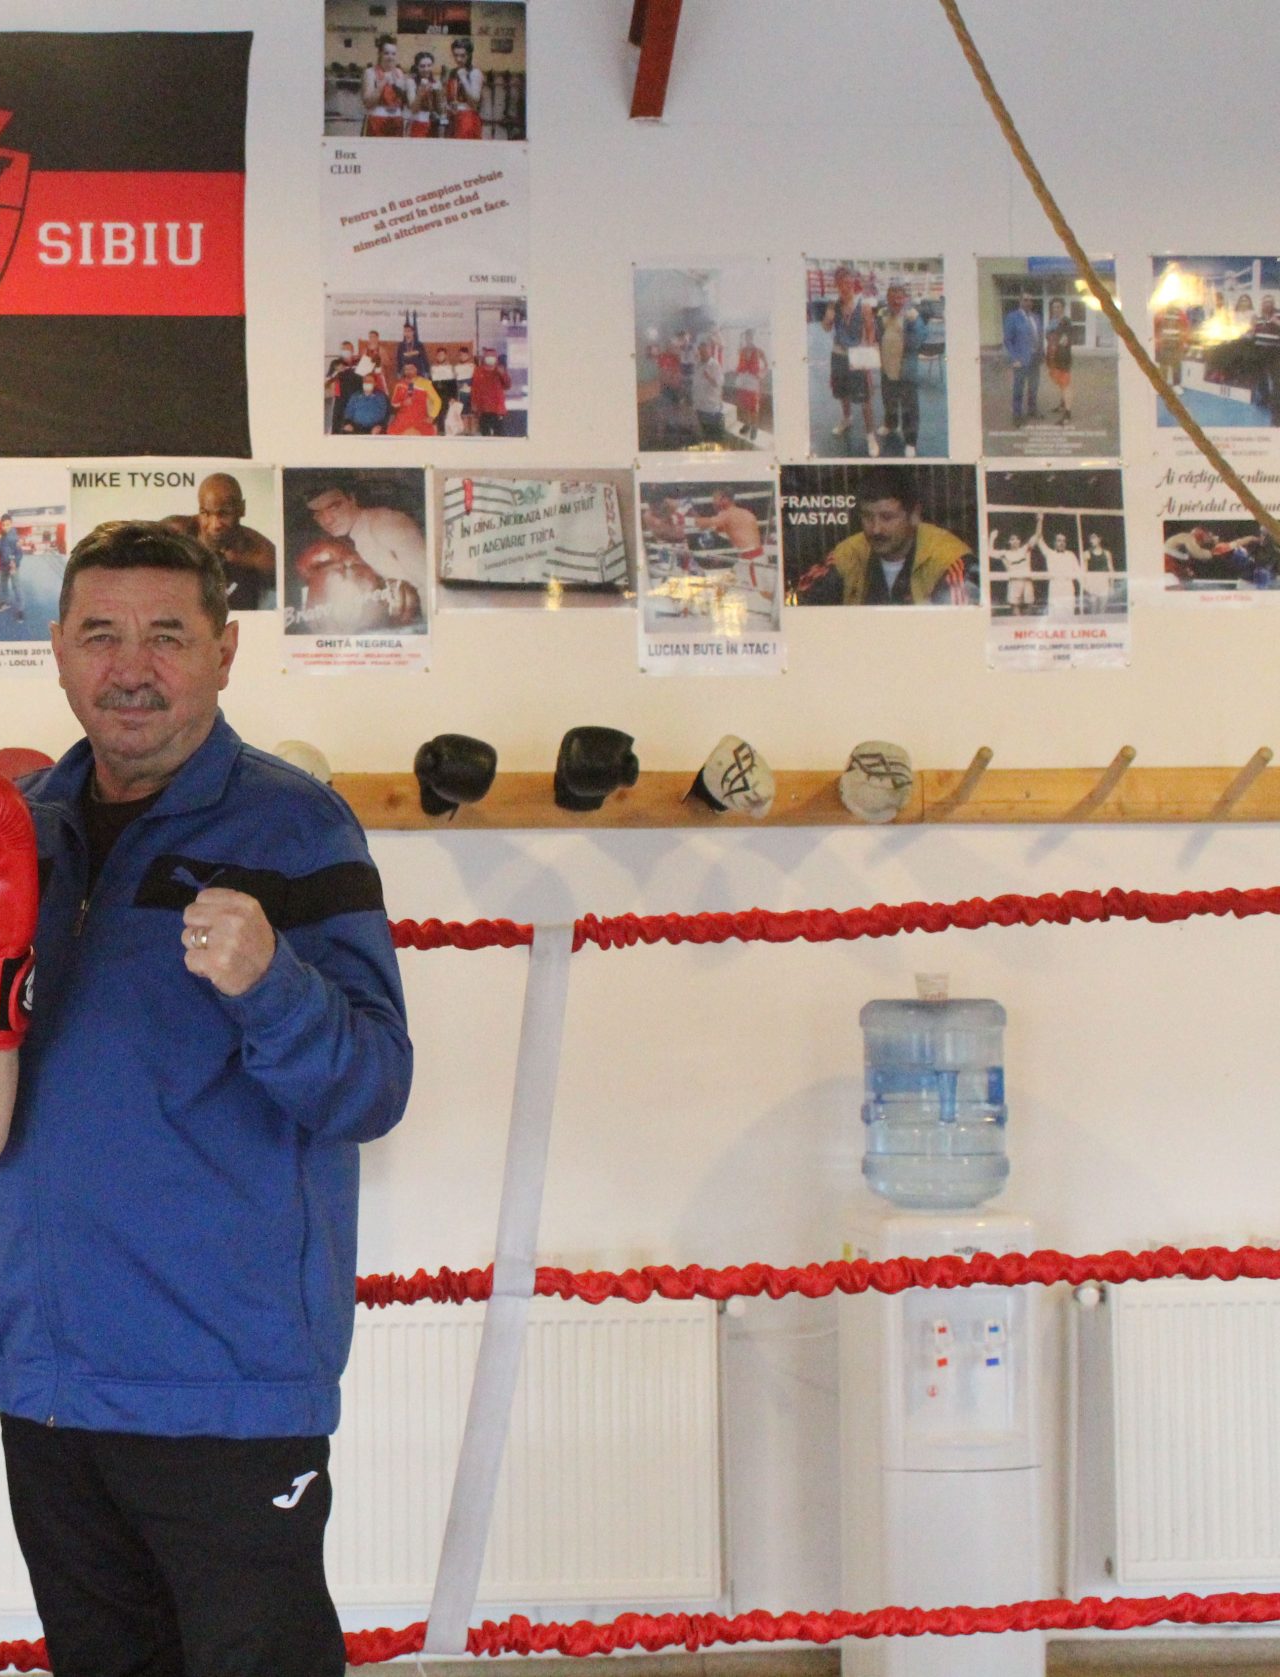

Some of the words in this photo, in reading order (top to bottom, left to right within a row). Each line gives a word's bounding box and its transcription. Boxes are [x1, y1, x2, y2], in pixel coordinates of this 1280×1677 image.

[334, 150, 357, 161] Box
[330, 164, 362, 175] CLUB
[340, 206, 378, 227] Pentru
[381, 205, 388, 215] a
[389, 201, 397, 213] fi
[399, 197, 414, 210] un
[416, 181, 463, 205] campion
[463, 168, 504, 190] trebuie
[388, 210, 416, 226] crezi
[430, 200, 451, 216] tine
[352, 234, 392, 254] nimeni
[393, 217, 444, 242] altcineva
[445, 212, 460, 225] nu
[469, 206, 483, 218] va
[36, 221, 204, 267] SIBIU
[469, 274, 489, 285] CSM
[71, 472, 121, 488] MIKE
[127, 471, 196, 488] TYSON
[1154, 467, 1176, 489] Ai
[780, 495, 857, 509] FRANCISC
[1155, 496, 1176, 518] Ai
[788, 512, 849, 526] VASTAG
[1013, 629, 1067, 640] NICOLAE
[1071, 628, 1108, 640] LINCA
[355, 639, 403, 649] NEGREA
[648, 643, 690, 657] LUCIAN
[692, 642, 724, 656] BUTE
[741, 642, 771, 655] ATAC
[9, 658, 38, 668] LOCUL
